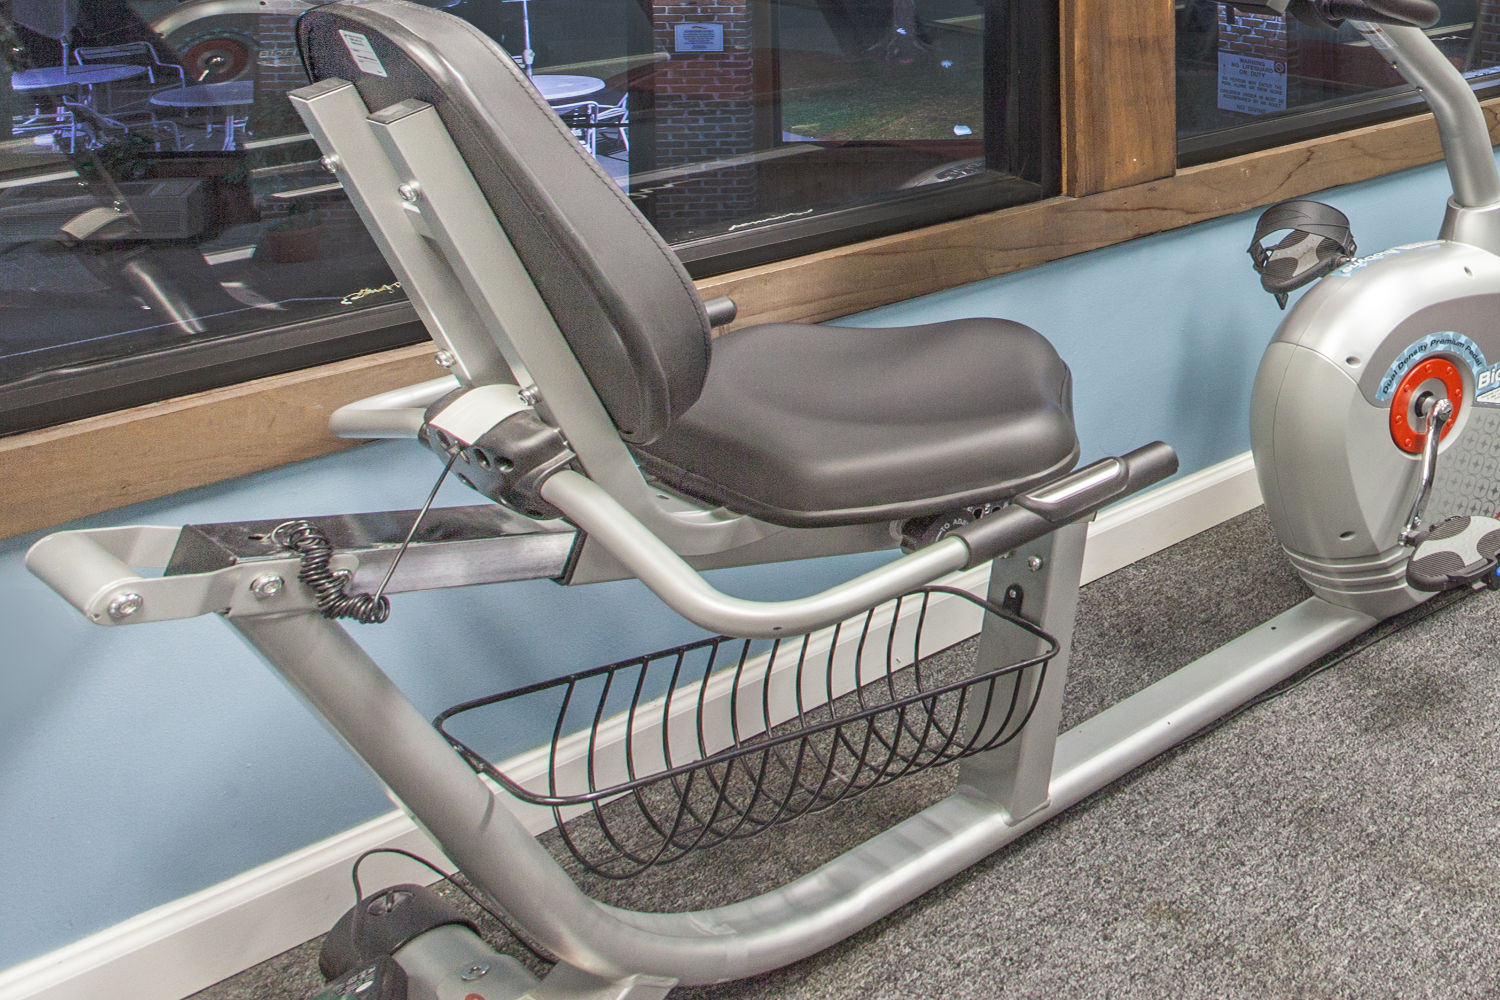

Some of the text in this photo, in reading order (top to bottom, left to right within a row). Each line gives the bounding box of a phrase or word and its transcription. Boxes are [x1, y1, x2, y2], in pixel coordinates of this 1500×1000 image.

[1382, 338, 1482, 394] Dual Density Premium Pedal
